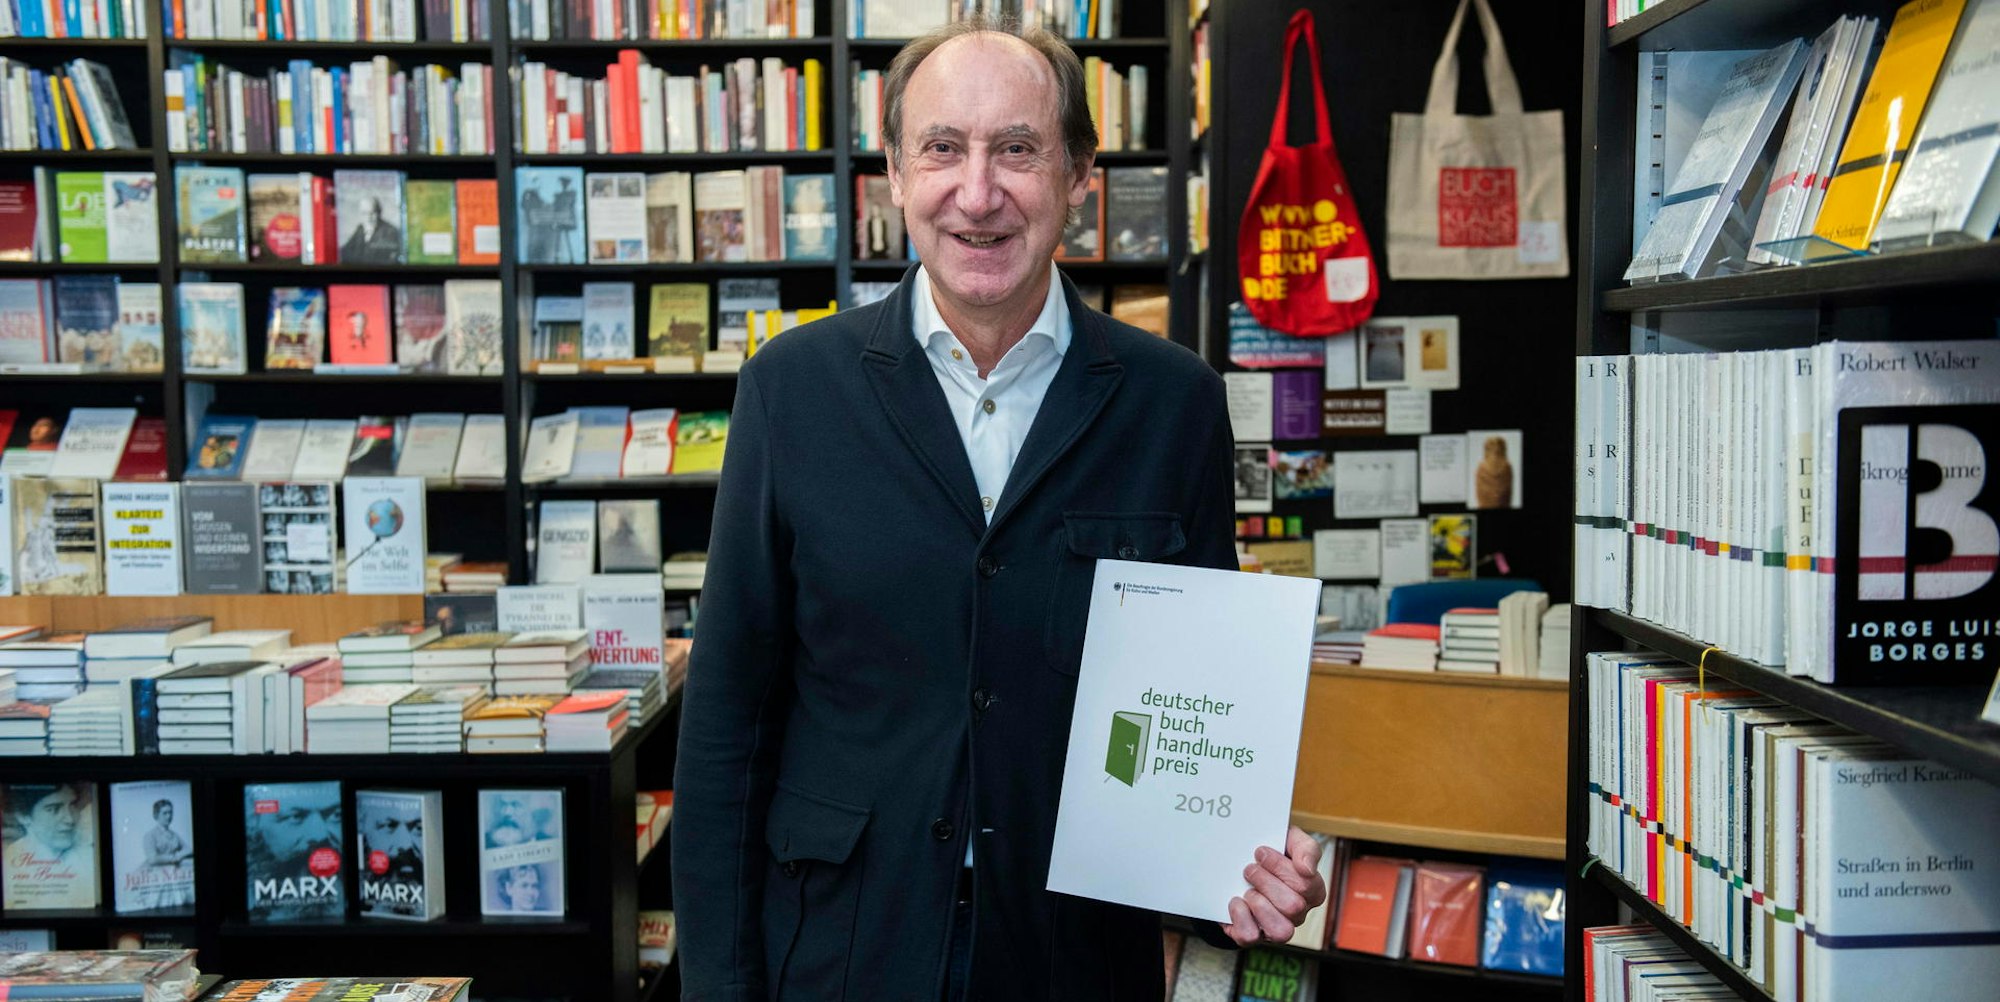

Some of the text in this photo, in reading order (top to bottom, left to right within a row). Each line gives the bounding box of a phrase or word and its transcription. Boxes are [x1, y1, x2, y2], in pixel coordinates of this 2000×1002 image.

[1442, 169, 1513, 197] BUCH
[1260, 251, 1317, 275] BUCH
[1840, 351, 1981, 372] Robert Walser
[115, 510, 164, 519] KLARTEXT
[192, 511, 214, 521] VOM
[130, 525, 150, 534] ZUR
[109, 540, 172, 549] INTEGRATION
[194, 543, 251, 554] WIDERSTAND
[383, 545, 409, 558] Welt
[361, 559, 410, 570] im Selfie
[595, 629, 628, 647] ENT-
[1847, 620, 1933, 638] JORGE
[588, 647, 659, 665] WERTUNG
[1869, 642, 1985, 662] BORGES
[1141, 687, 1235, 716] deutscher
[1160, 711, 1205, 734] buch
[1156, 732, 1255, 768] handlungs
[1153, 755, 1199, 776] preis
[1836, 766, 1907, 788] Siegfried
[1174, 793, 1233, 818] 2018
[1837, 854, 1974, 874] Straßen in Berlin
[254, 875, 339, 901] MARX
[363, 880, 424, 904] MARX
[1837, 880, 1951, 898] und anderswo
[1243, 969, 1298, 1002] TUN?
